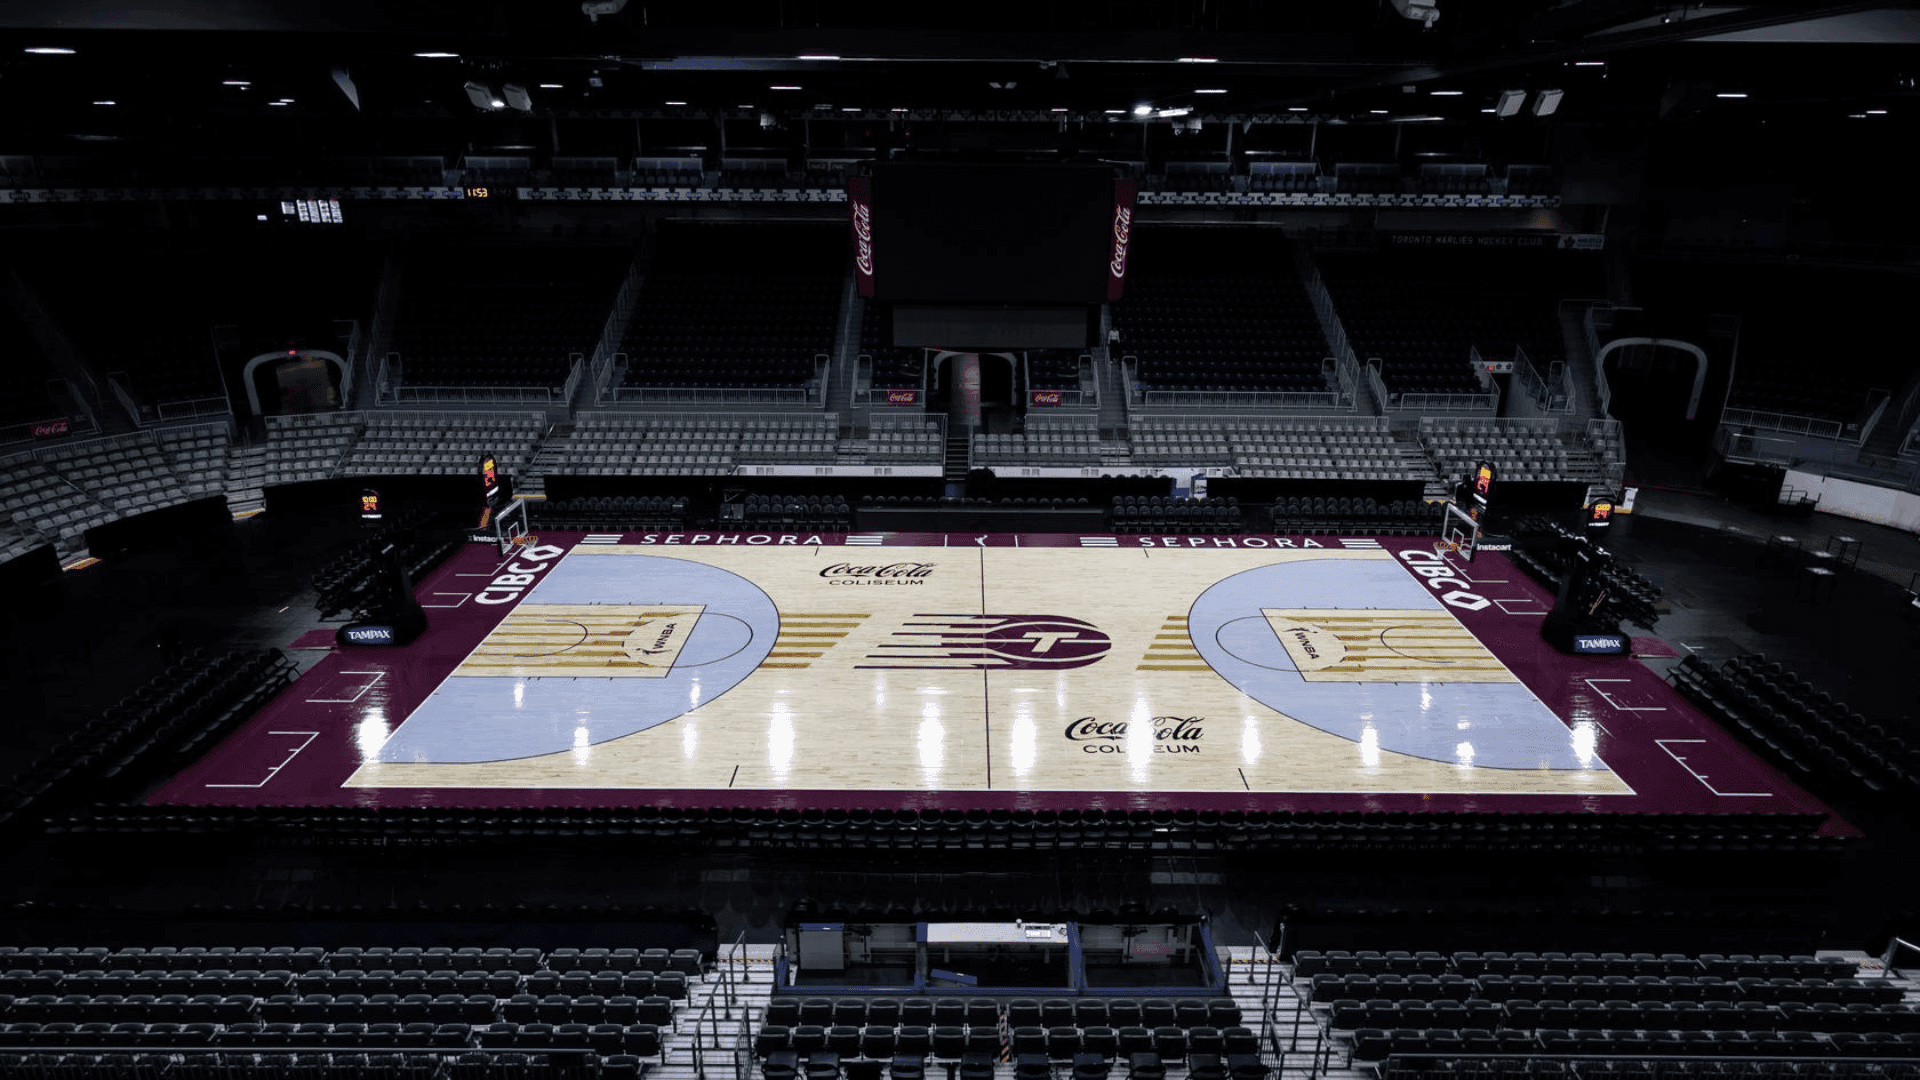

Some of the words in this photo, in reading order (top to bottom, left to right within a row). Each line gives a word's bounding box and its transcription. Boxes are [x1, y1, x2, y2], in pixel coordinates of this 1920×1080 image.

[853, 199, 873, 276] Coca-Cola
[1111, 204, 1131, 278] Coca-Cola
[640, 534, 824, 545] SEPHORA
[1138, 537, 1324, 548] SEPHORA
[819, 562, 939, 578] Coca-Cola
[1399, 549, 1471, 590] CIBC
[475, 562, 549, 605] CIBC
[348, 630, 391, 639] TAMPAX
[1579, 638, 1620, 648] TAMPAX
